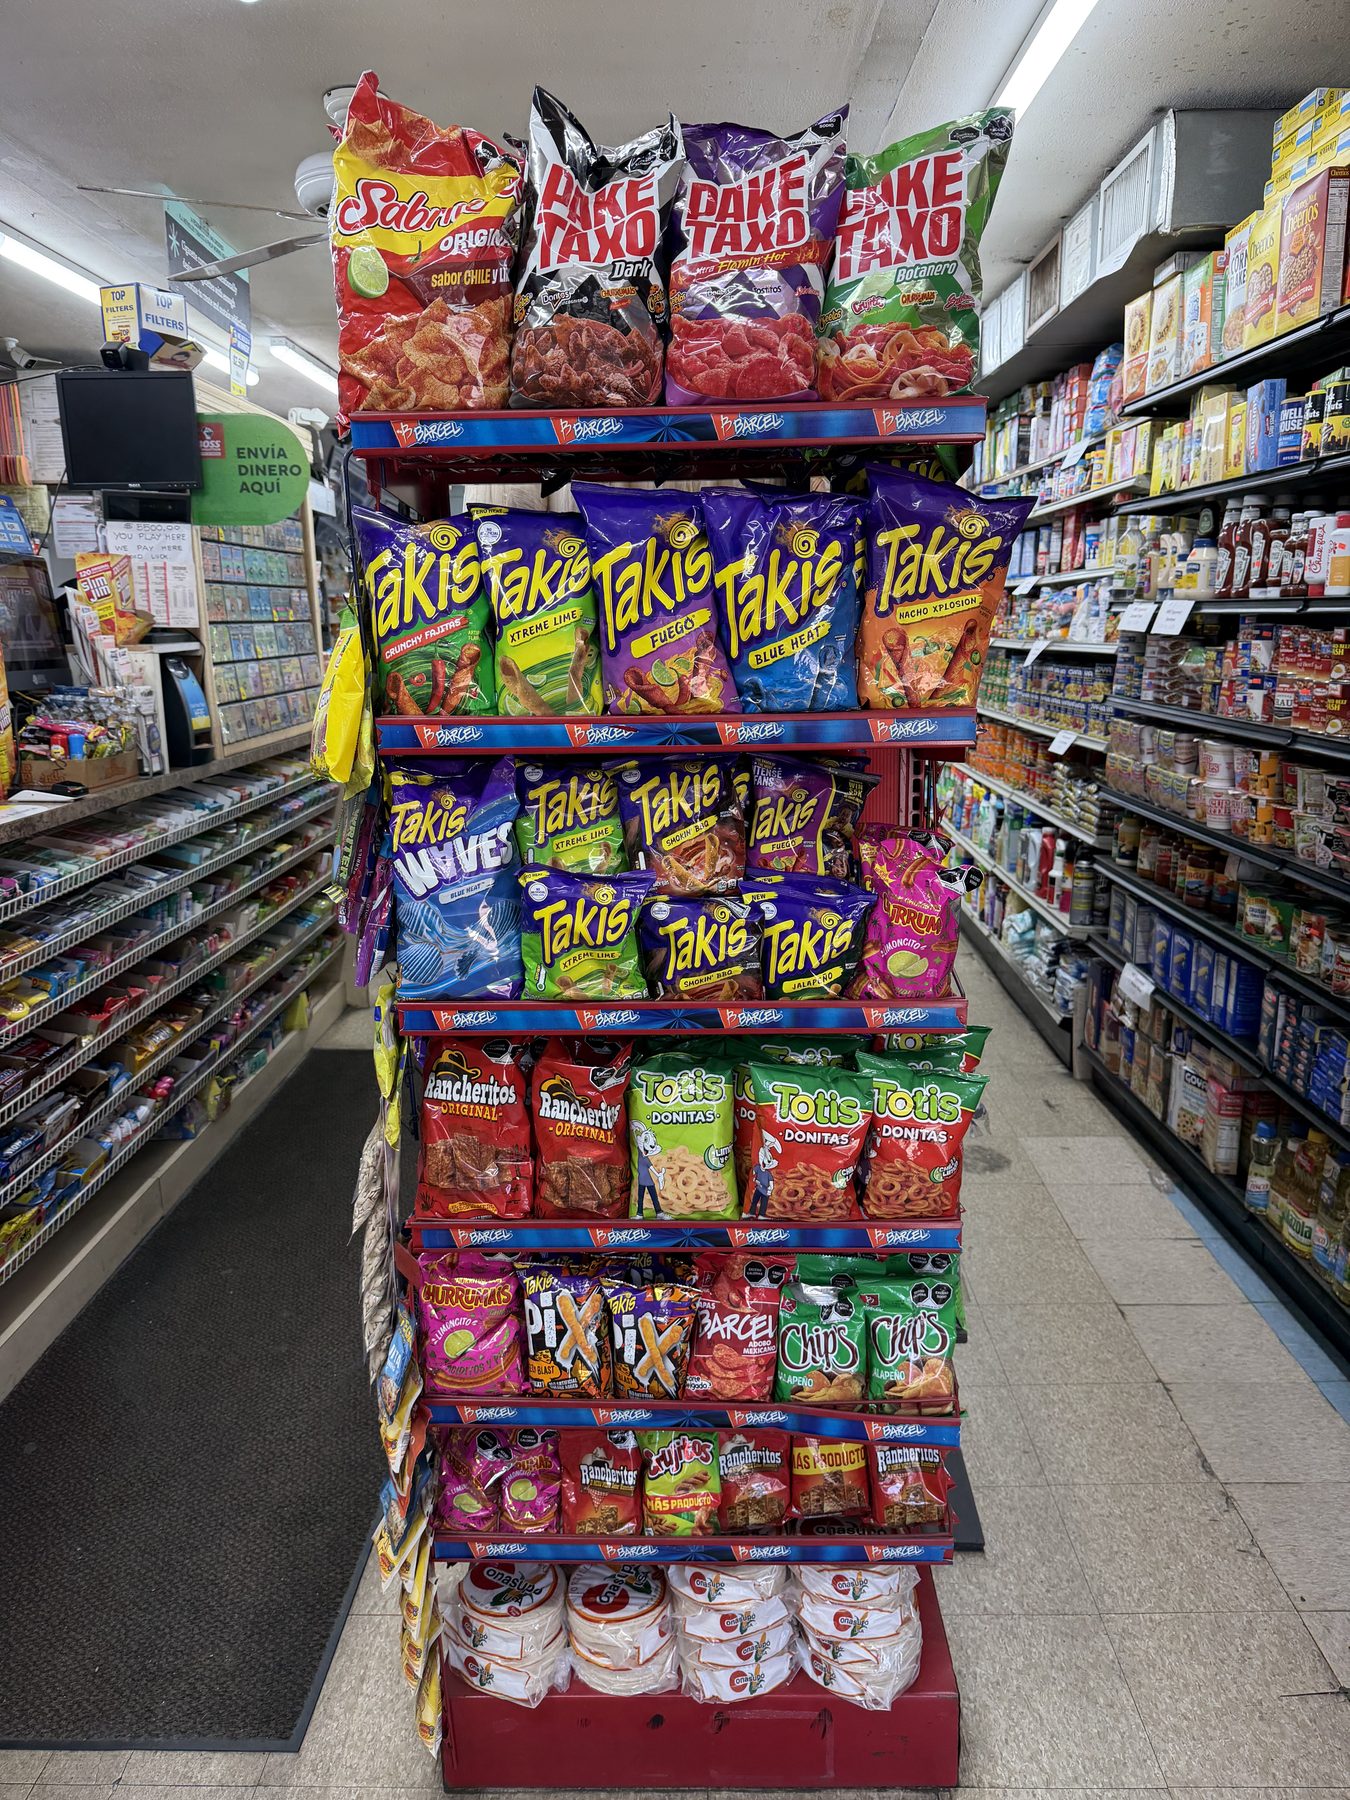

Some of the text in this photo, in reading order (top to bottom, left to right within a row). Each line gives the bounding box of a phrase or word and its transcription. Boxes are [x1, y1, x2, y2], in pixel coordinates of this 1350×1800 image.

[1283, 202, 1319, 237] Cheerios
[537, 210, 657, 270] TAXO
[686, 210, 807, 262] TAXO
[837, 207, 961, 281] TAXO
[1249, 231, 1275, 262] Cheerios
[431, 271, 462, 289] sabor
[464, 268, 491, 285] CHILE
[612, 260, 652, 280] Dark
[896, 261, 957, 285] Botanero
[110, 290, 126, 301] TOP
[155, 294, 173, 309] TOP
[106, 304, 134, 313] FILTERS
[145, 312, 184, 331] FILTERS
[573, 417, 623, 440] BARCEL
[733, 413, 783, 437] BARCEL
[895, 409, 946, 433] BARCEL
[1280, 419, 1303, 433] OUSE
[413, 421, 463, 444] BARCEL
[237, 443, 288, 459] ENVÍA
[238, 464, 302, 476] DINERO
[240, 478, 280, 496] AQUÍ
[113, 532, 186, 541] YOU PLAY HERE
[877, 523, 1002, 612] Takis
[365, 542, 481, 655] Takis
[481, 546, 591, 635] Takis
[592, 536, 712, 651] Takis
[714, 540, 843, 659] Takis
[898, 597, 977, 620] NACHO XPLOSION
[510, 609, 578, 642] XTREME LIME
[650, 614, 696, 648] FUEGO
[384, 632, 423, 658] CRUNCHY
[423, 618, 462, 641] FAJITAS
[755, 627, 822, 665] BLUE HEAT
[435, 725, 481, 747] BARCEL
[736, 723, 784, 745] BARCEL
[889, 721, 937, 742] BARCEL
[528, 775, 618, 845] Takis
[630, 764, 721, 847] Takis
[391, 800, 467, 853] Takis
[749, 796, 818, 848] Takis
[555, 827, 610, 850] XTREME LIME
[665, 828, 694, 847] SMOKIN'
[771, 839, 796, 851] FUEGO
[393, 821, 515, 896] WAVES
[450, 883, 482, 899] BLUE HEAT
[751, 893, 766, 901] NEW
[534, 898, 630, 964] Takis
[659, 915, 748, 980] Takis
[764, 917, 853, 984] Takis
[562, 951, 616, 970] XTREME LIME
[683, 969, 734, 988] SMOKIN' BBQ
[791, 971, 833, 990] JALAPEÑO
[453, 1009, 497, 1027] BARCEL
[595, 1009, 640, 1027] BARCEL
[738, 1008, 783, 1027] BARCEL
[882, 1008, 928, 1026] BARCEL
[423, 1073, 518, 1106] Rancheritos
[639, 1067, 726, 1104] Totis
[441, 1101, 498, 1121] ORIGINAL
[538, 1090, 620, 1129] Rancheritos
[773, 1083, 862, 1126] Totis
[873, 1079, 962, 1124] Totis
[652, 1111, 715, 1125] DONITAS
[554, 1122, 614, 1144] ORIGINAL
[784, 1129, 849, 1145] DONITAS
[882, 1127, 947, 1143] DONITAS
[470, 1229, 513, 1245] BARCEL
[608, 1229, 651, 1245] BARCEL
[745, 1229, 789, 1245] BARCEL
[885, 1229, 929, 1245] BARCEL
[523, 1274, 553, 1295] Takis
[608, 1294, 637, 1315] Takis
[435, 1317, 472, 1340] LIMONCITO
[698, 1309, 777, 1341] BARCEL
[780, 1322, 860, 1371] Chip's
[870, 1310, 949, 1366] Chip's
[743, 1346, 776, 1355] MEXICANO
[537, 1364, 555, 1375] BLAST
[475, 1407, 517, 1421] BARCEL
[610, 1408, 652, 1422] BARCEL
[745, 1410, 788, 1424] BARCEL
[883, 1423, 926, 1438] BARCEL
[643, 1436, 713, 1478] Crujitos
[719, 1446, 782, 1476] Rancheritos
[877, 1446, 940, 1473] Rancheritos
[579, 1464, 638, 1485] Rancheritos
[670, 1495, 712, 1509] PRODUCTO
[486, 1543, 527, 1557] BARCEL
[617, 1544, 659, 1558] BARCEL
[749, 1545, 792, 1559] BARCEL
[882, 1545, 925, 1559] BARCEL
